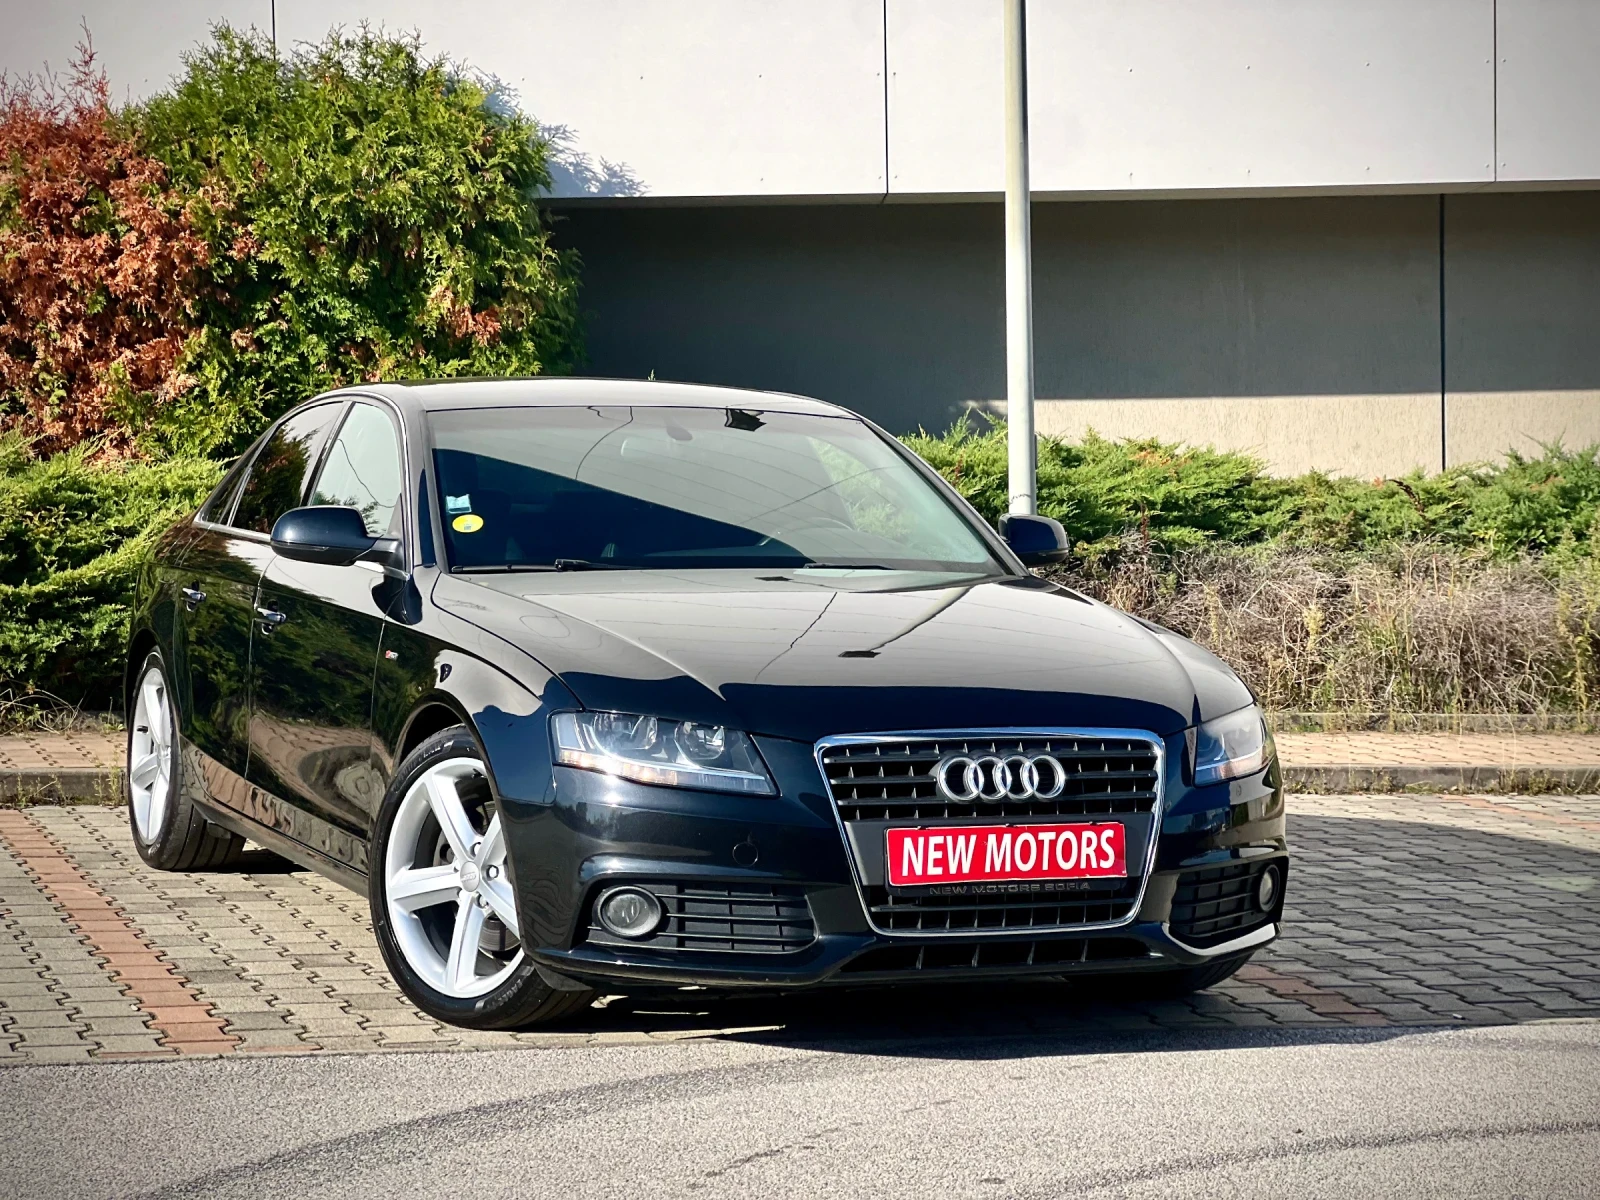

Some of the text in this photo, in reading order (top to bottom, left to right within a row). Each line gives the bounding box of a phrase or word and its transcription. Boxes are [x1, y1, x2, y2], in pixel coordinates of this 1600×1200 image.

[902, 829, 1115, 876] NEW MOTORS
[929, 885, 967, 895] NEW
[972, 884, 1041, 894] MOTORS
